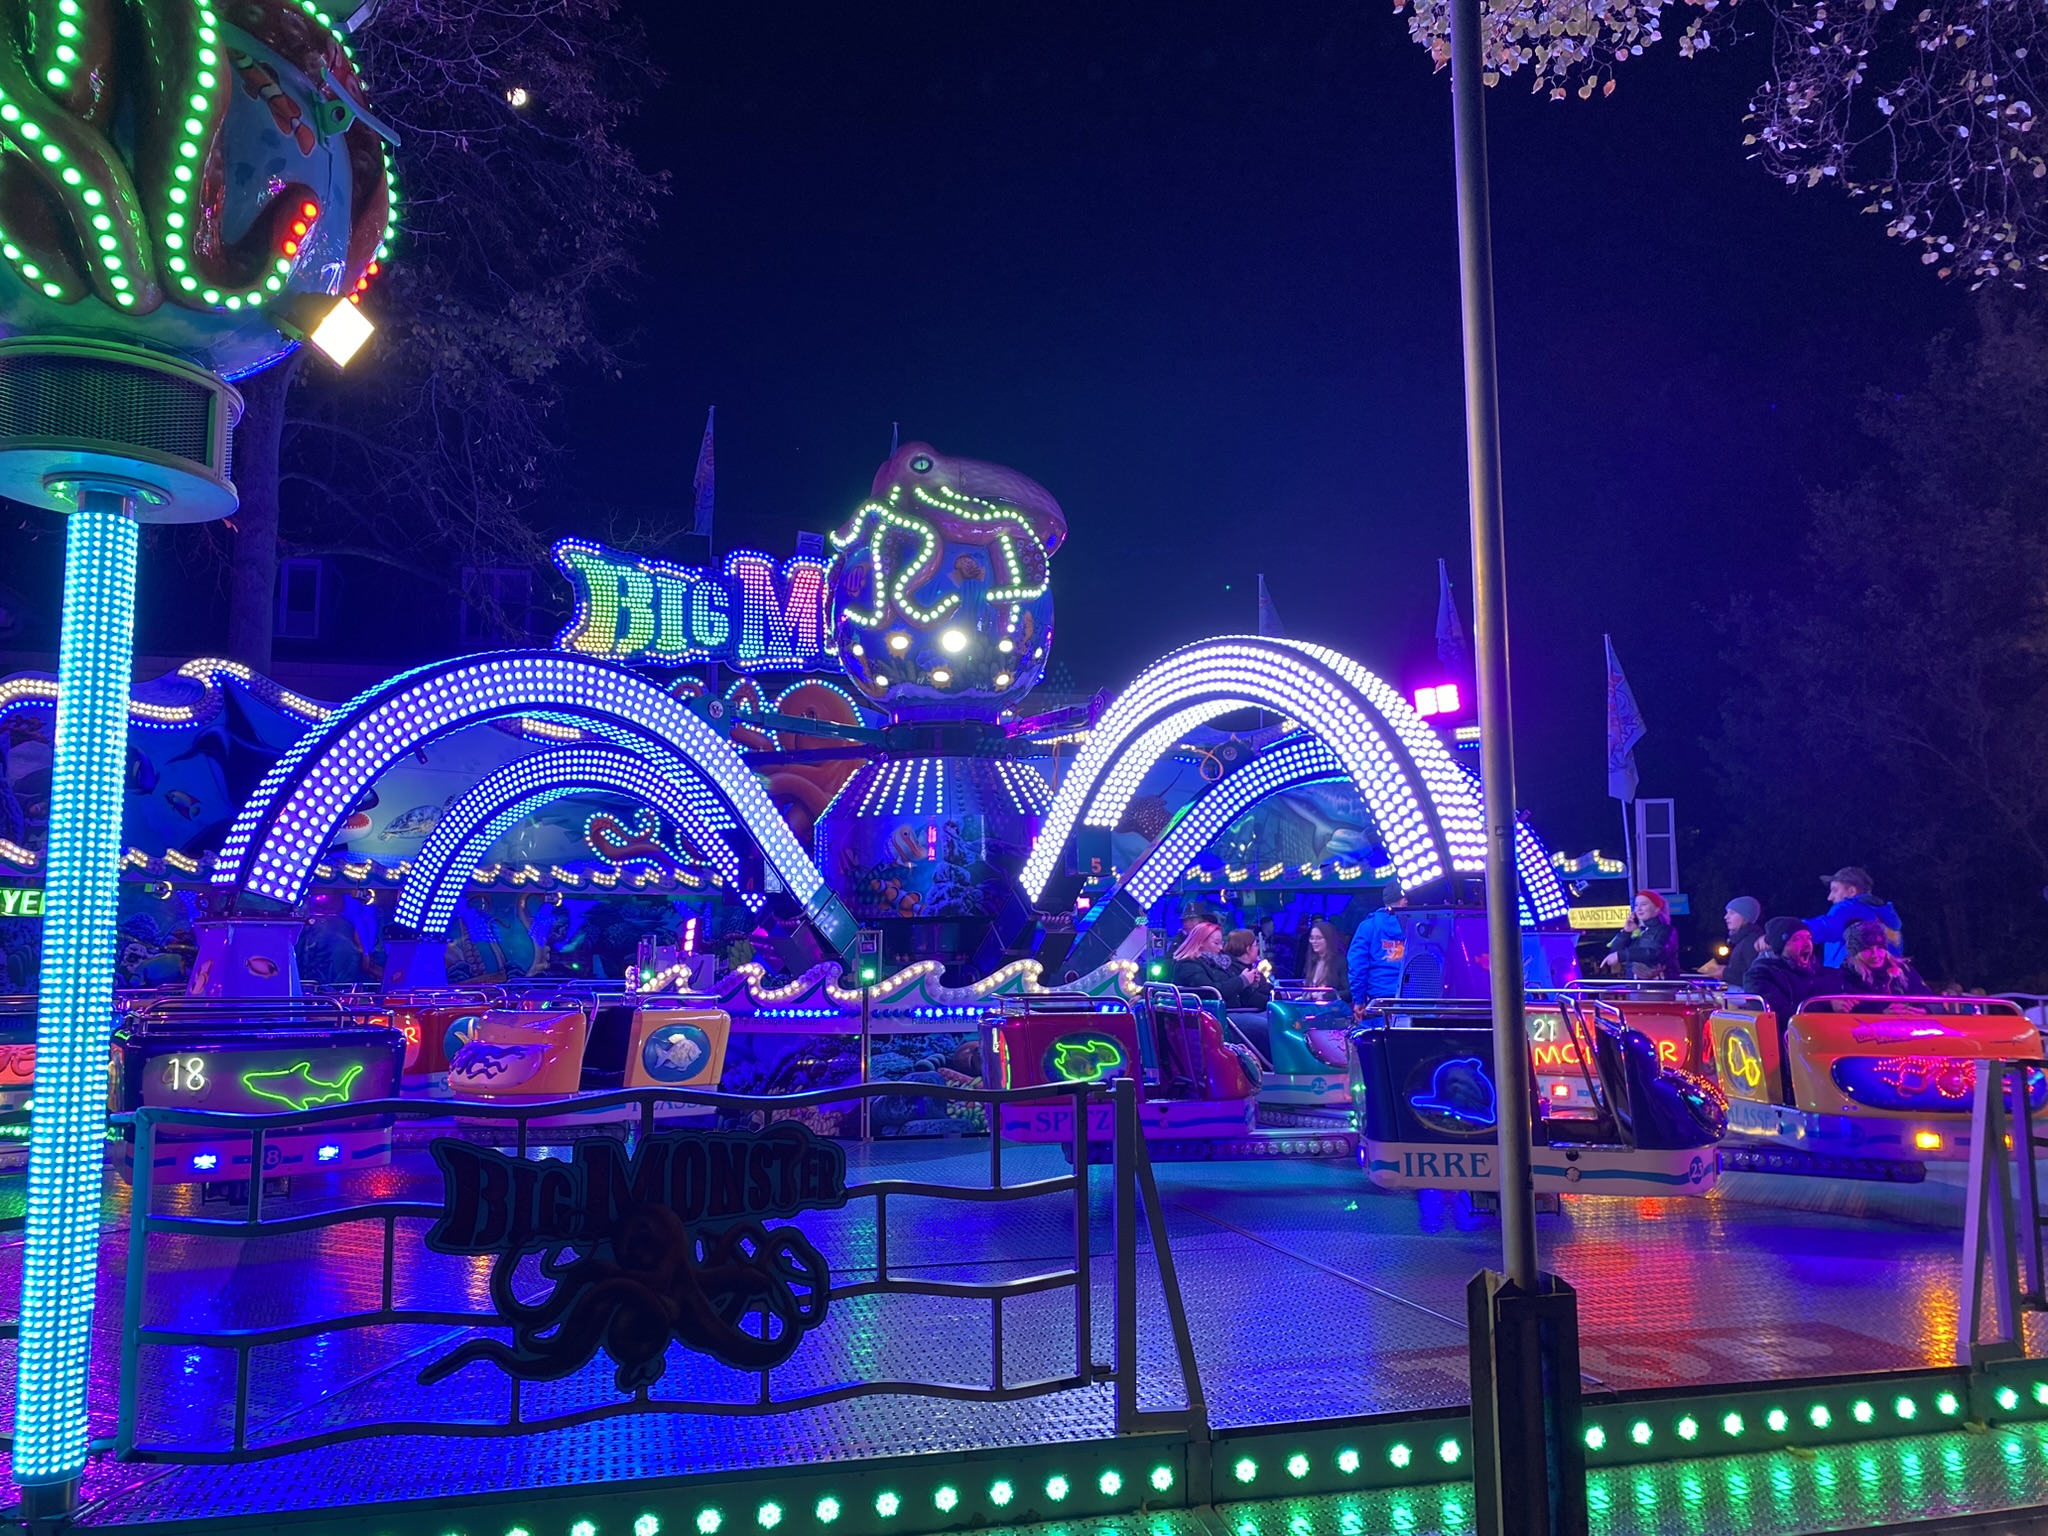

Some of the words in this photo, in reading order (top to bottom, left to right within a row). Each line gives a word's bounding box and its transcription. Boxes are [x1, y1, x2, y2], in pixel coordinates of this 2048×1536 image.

[567, 552, 731, 654] BIG
[1091, 857, 1102, 873] 5
[911, 1017, 950, 1025] Rauchen
[1533, 1018, 1557, 1042] 21
[169, 1057, 206, 1091] 18
[1313, 1080, 1327, 1091] 25
[1403, 1151, 1492, 1178] IRRE
[437, 1147, 574, 1247] BIG
[583, 1140, 837, 1235] MONSTER
